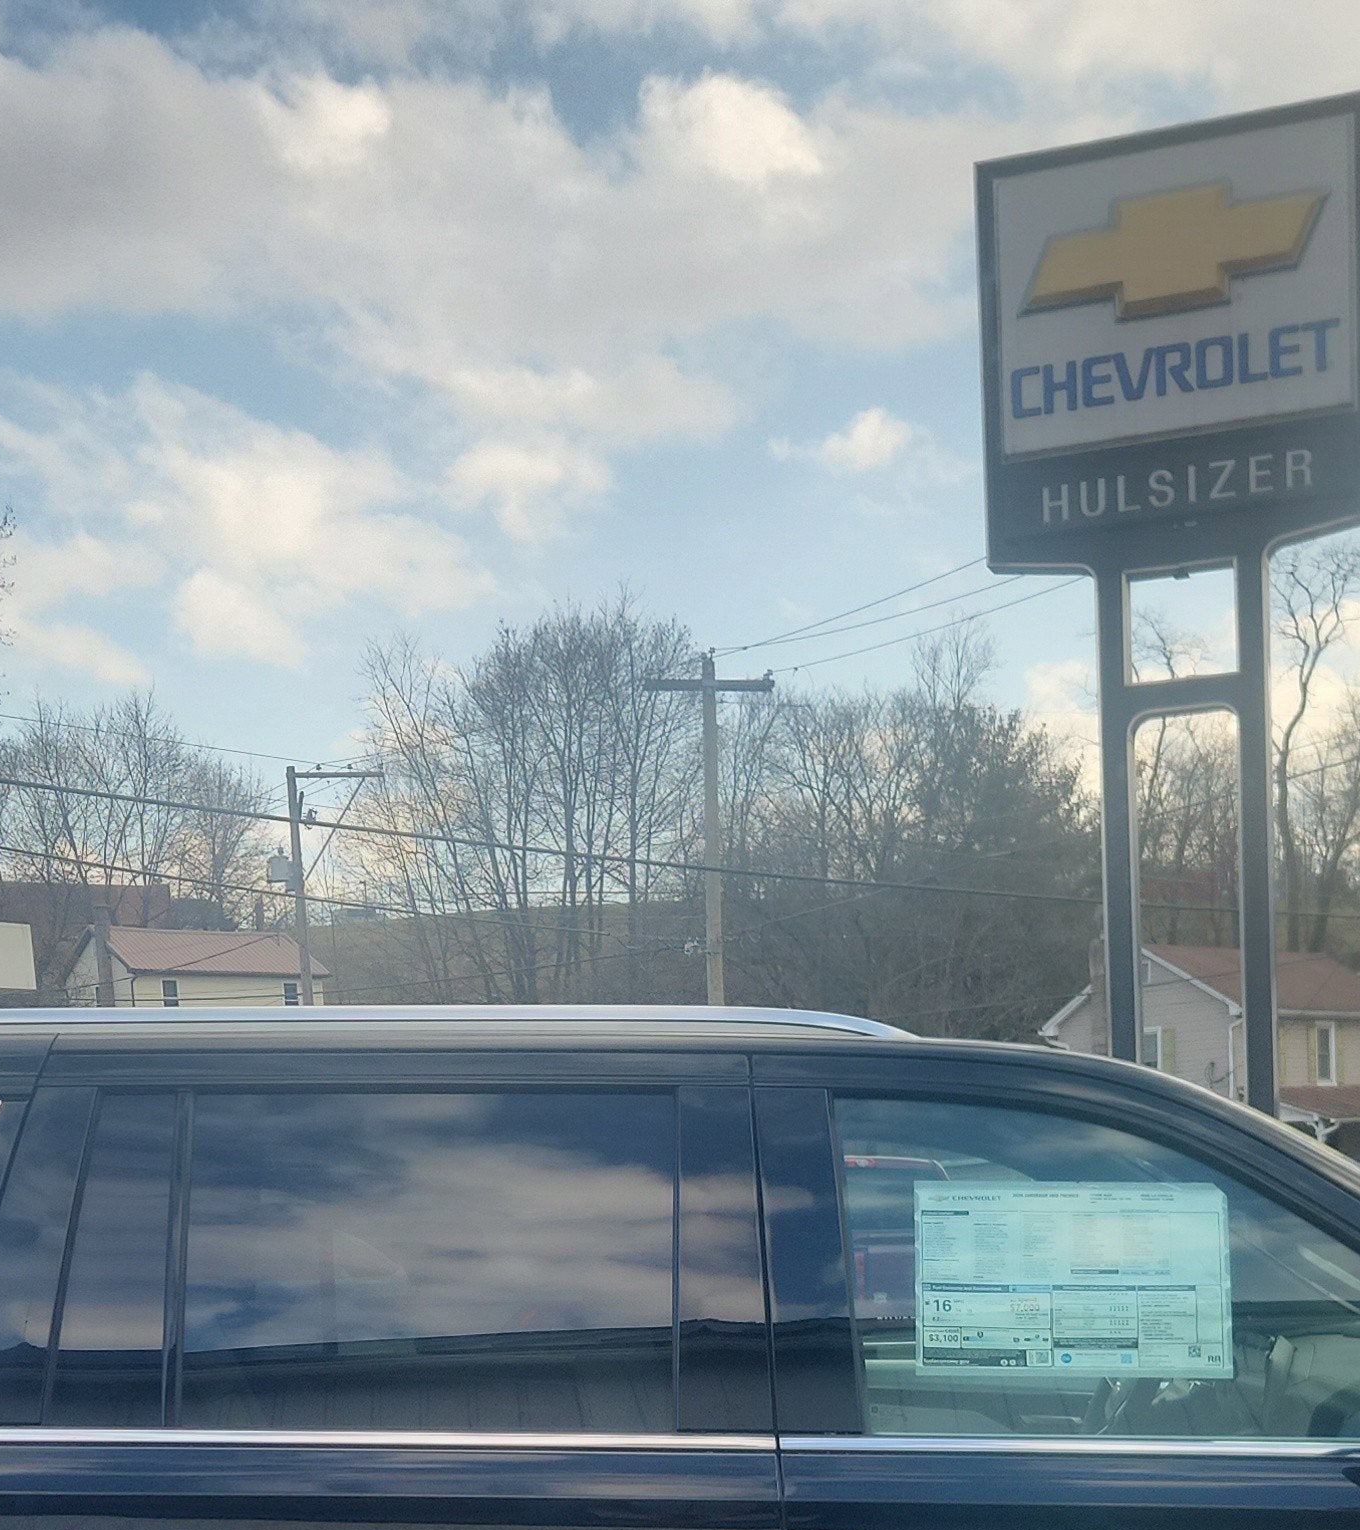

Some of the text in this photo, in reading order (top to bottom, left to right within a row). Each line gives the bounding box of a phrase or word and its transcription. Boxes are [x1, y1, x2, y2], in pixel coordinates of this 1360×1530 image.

[1010, 317, 1341, 420] CHEVROLET
[1041, 449, 1314, 524] HULSIZER
[933, 1299, 952, 1313] 16
[928, 1333, 959, 1343] $3,100
